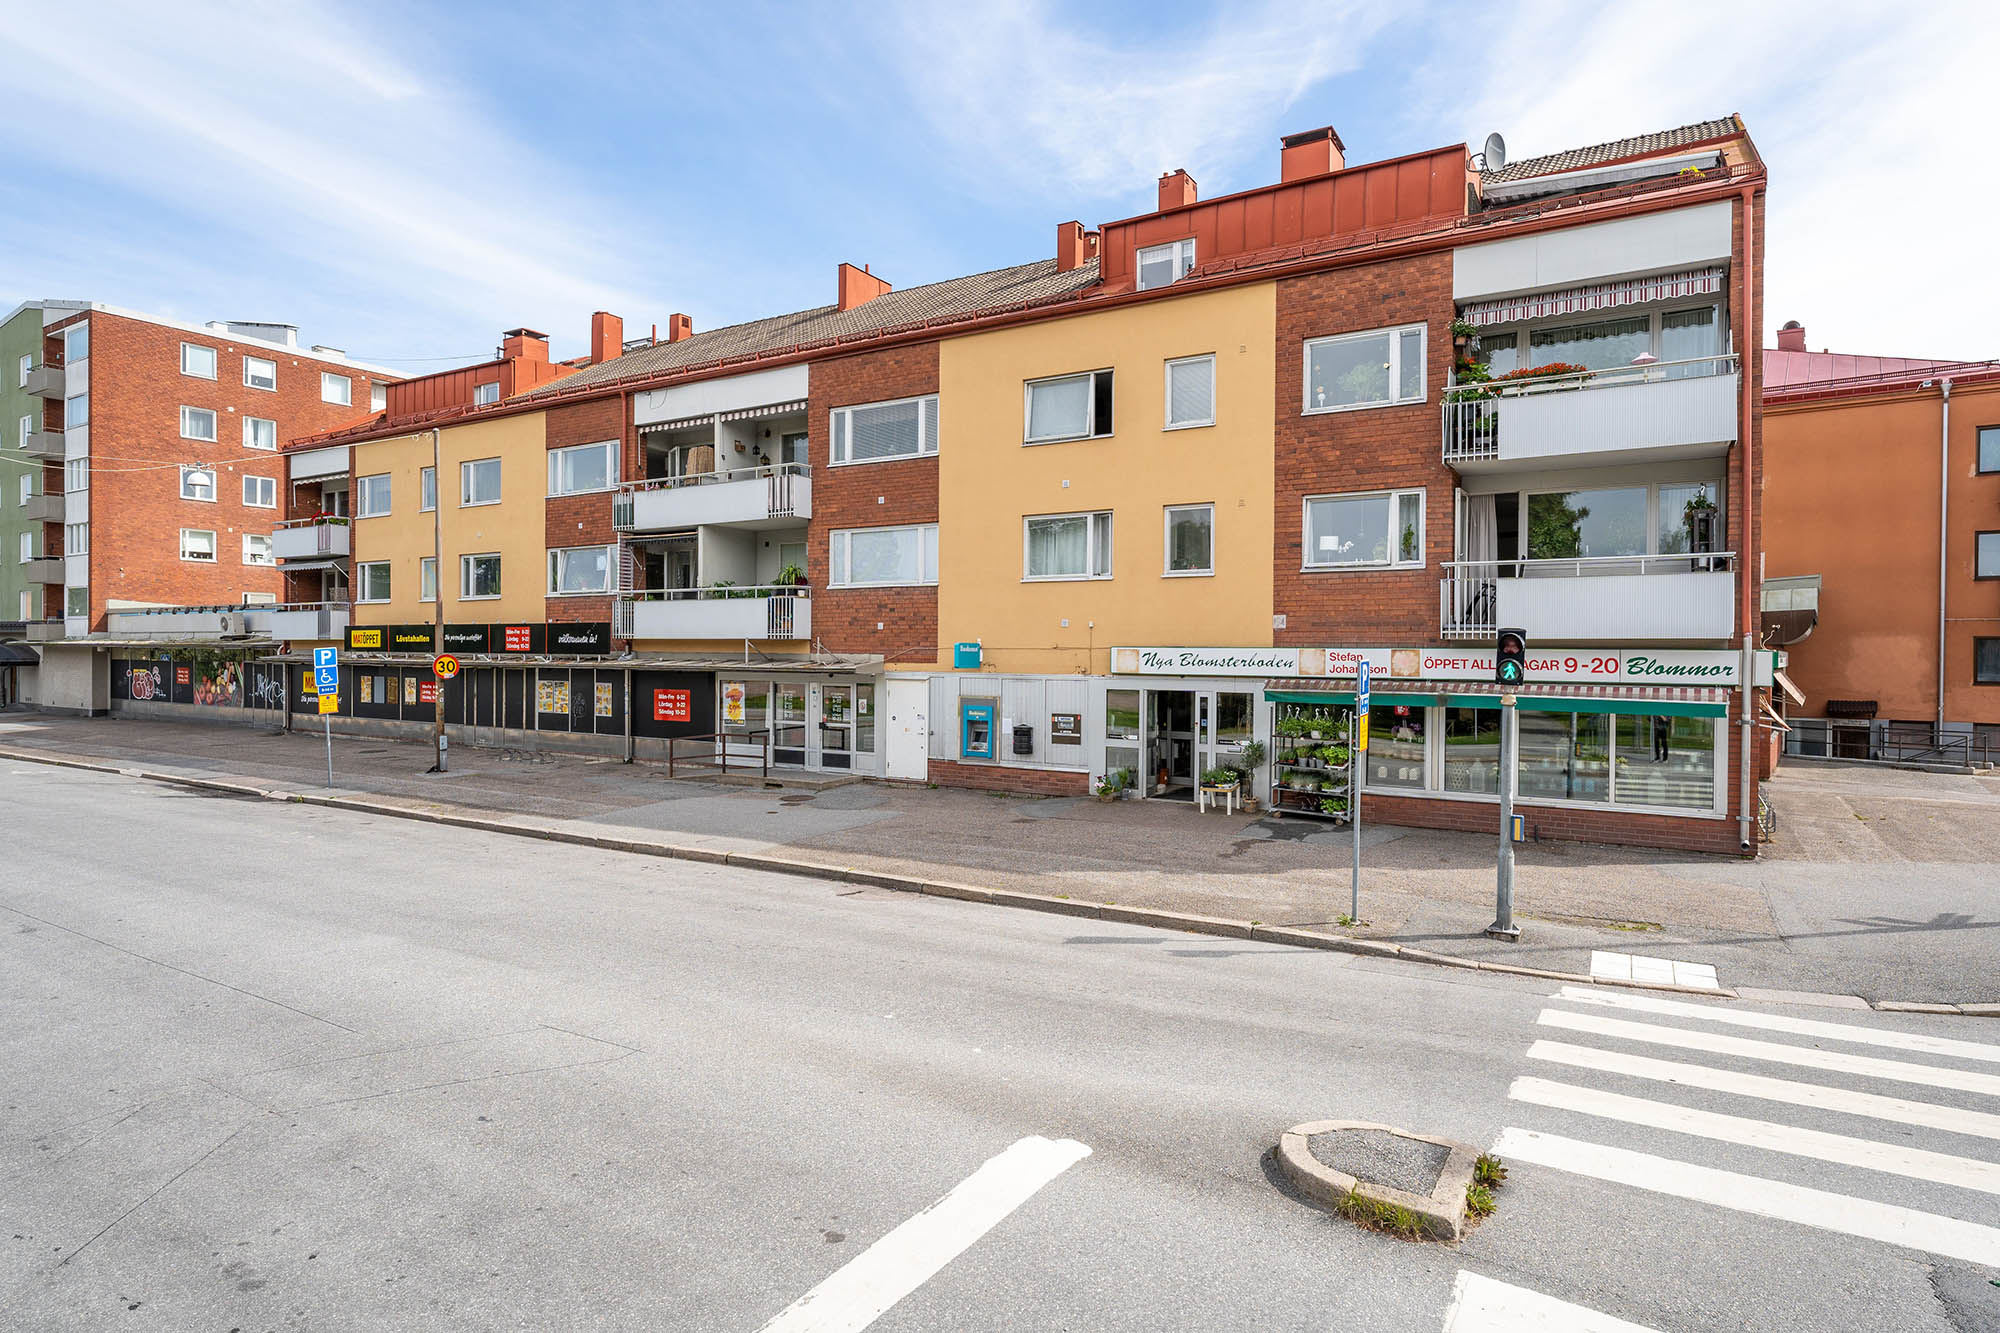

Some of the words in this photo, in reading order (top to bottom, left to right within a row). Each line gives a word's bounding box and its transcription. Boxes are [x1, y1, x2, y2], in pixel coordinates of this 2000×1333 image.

[353, 632, 379, 645] MATÖPPET
[321, 650, 332, 665] P
[1142, 652, 1173, 670] Nya
[1179, 652, 1295, 668] Blomsterboden
[1329, 652, 1363, 661] Stefan
[438, 661, 455, 672] 30
[1424, 656, 1469, 669] ÖPPET
[1564, 657, 1618, 674] 9-20
[1626, 656, 1734, 676] Blommor
[1362, 664, 1367, 692] P
